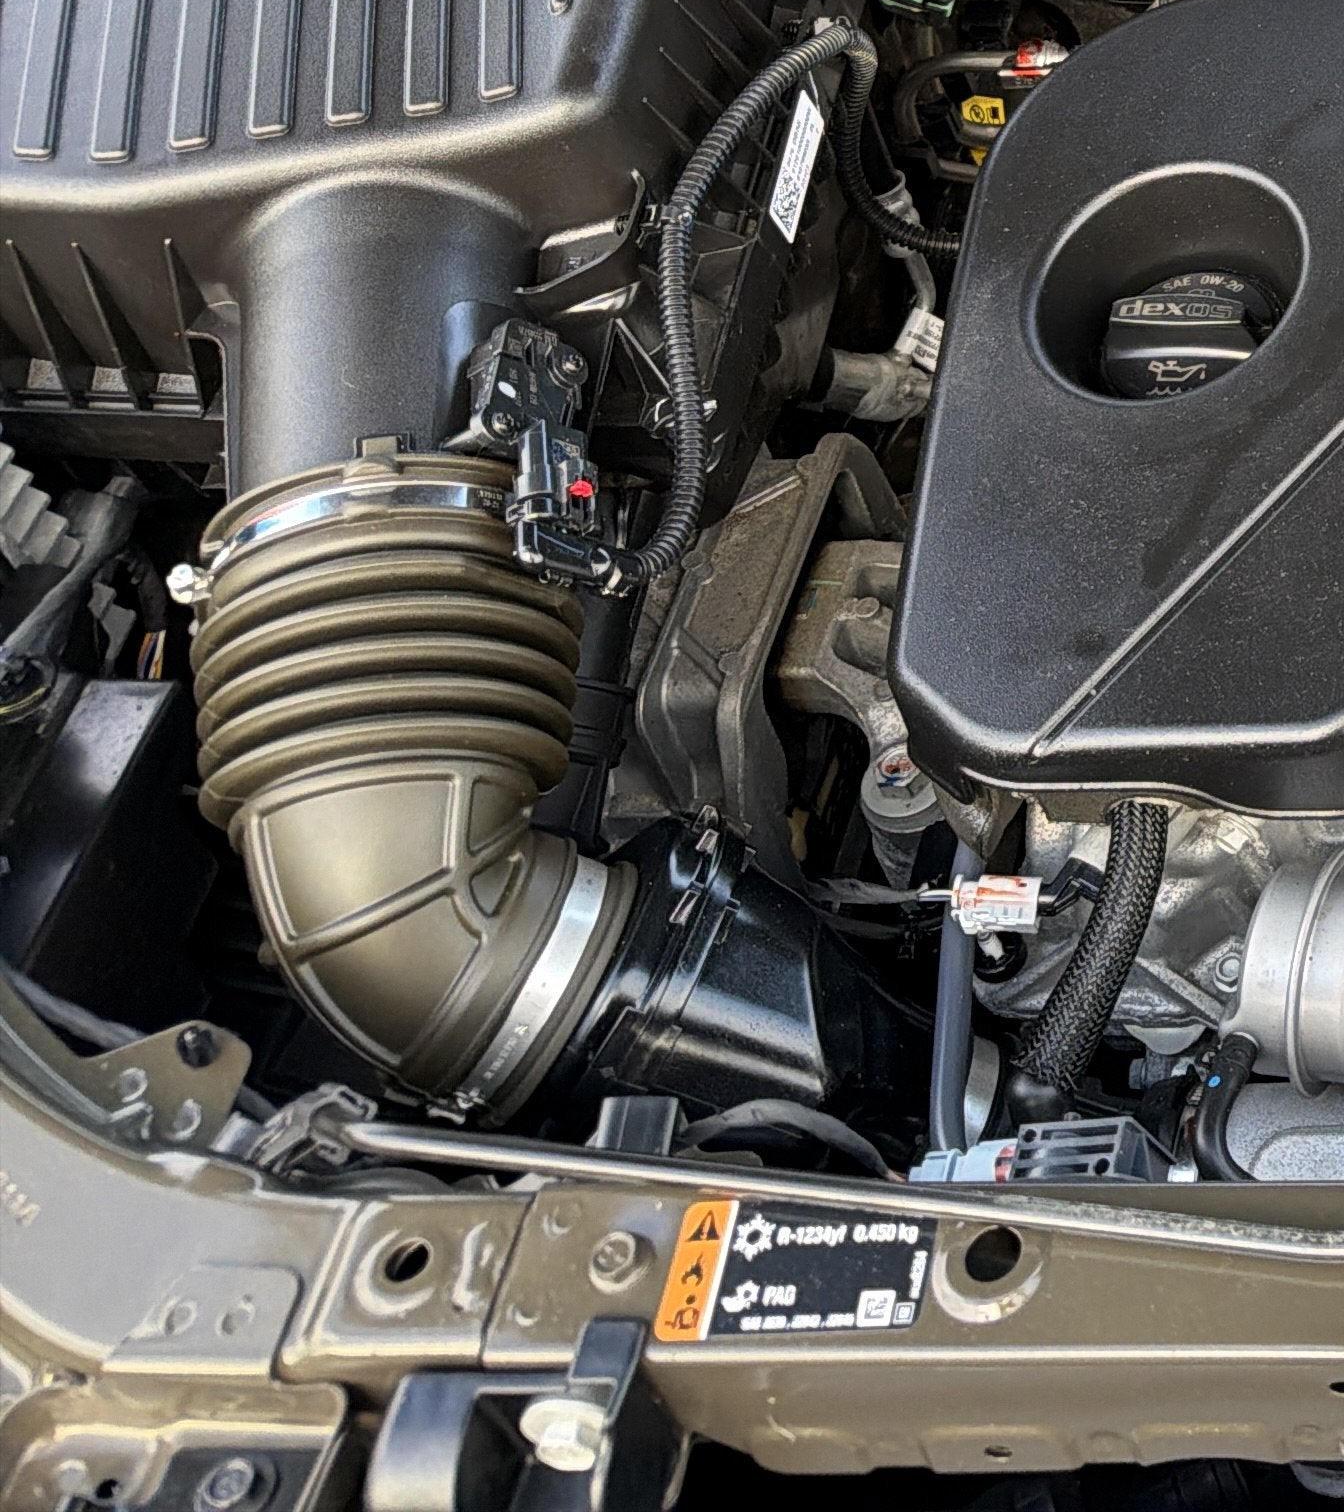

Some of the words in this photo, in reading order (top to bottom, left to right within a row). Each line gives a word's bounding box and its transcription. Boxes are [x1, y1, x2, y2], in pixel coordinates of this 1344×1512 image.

[1162, 276, 1192, 293] SAE
[1200, 274, 1244, 293] 0W-20
[1118, 299, 1234, 318] dexos
[853, 1222, 896, 1244] 0.450
[898, 1222, 919, 1244] kg
